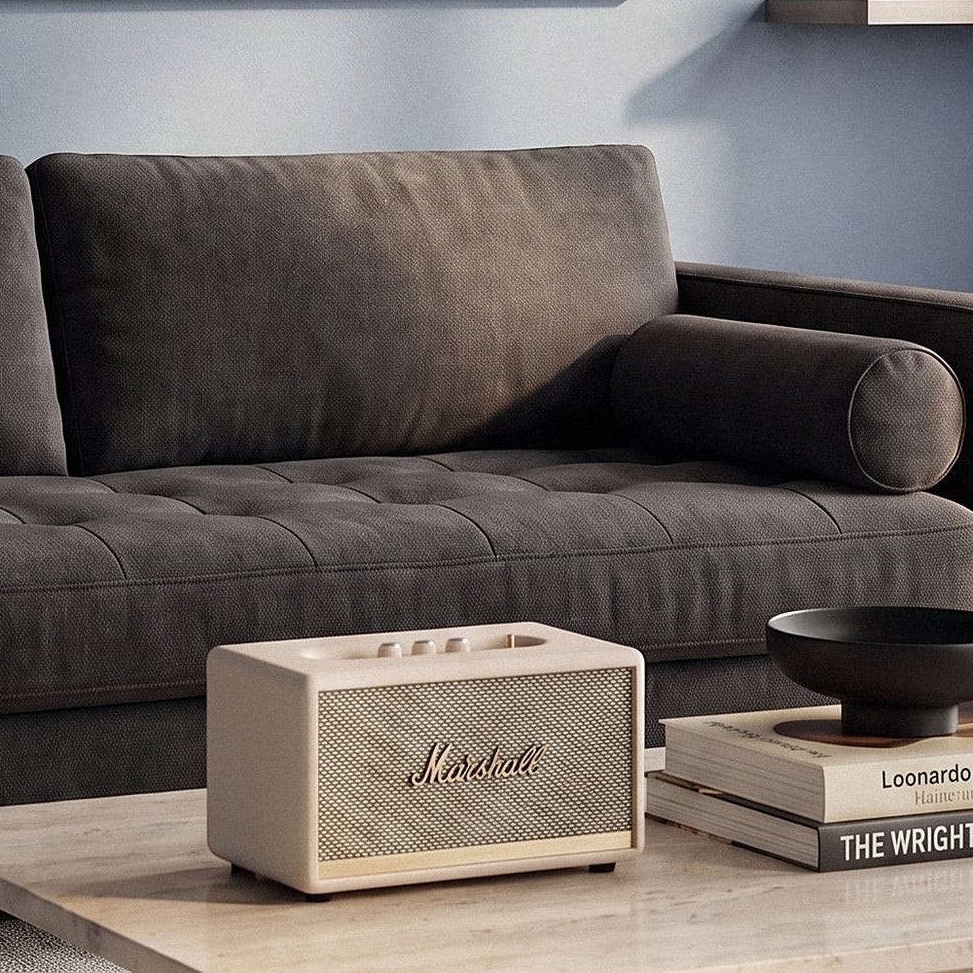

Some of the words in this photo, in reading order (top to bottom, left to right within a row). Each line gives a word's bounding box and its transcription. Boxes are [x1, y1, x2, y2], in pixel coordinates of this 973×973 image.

[411, 742, 548, 786] Marshall
[882, 763, 971, 789] Loonardo
[840, 831, 885, 861] THE
[890, 822, 973, 856] WRIGHT
